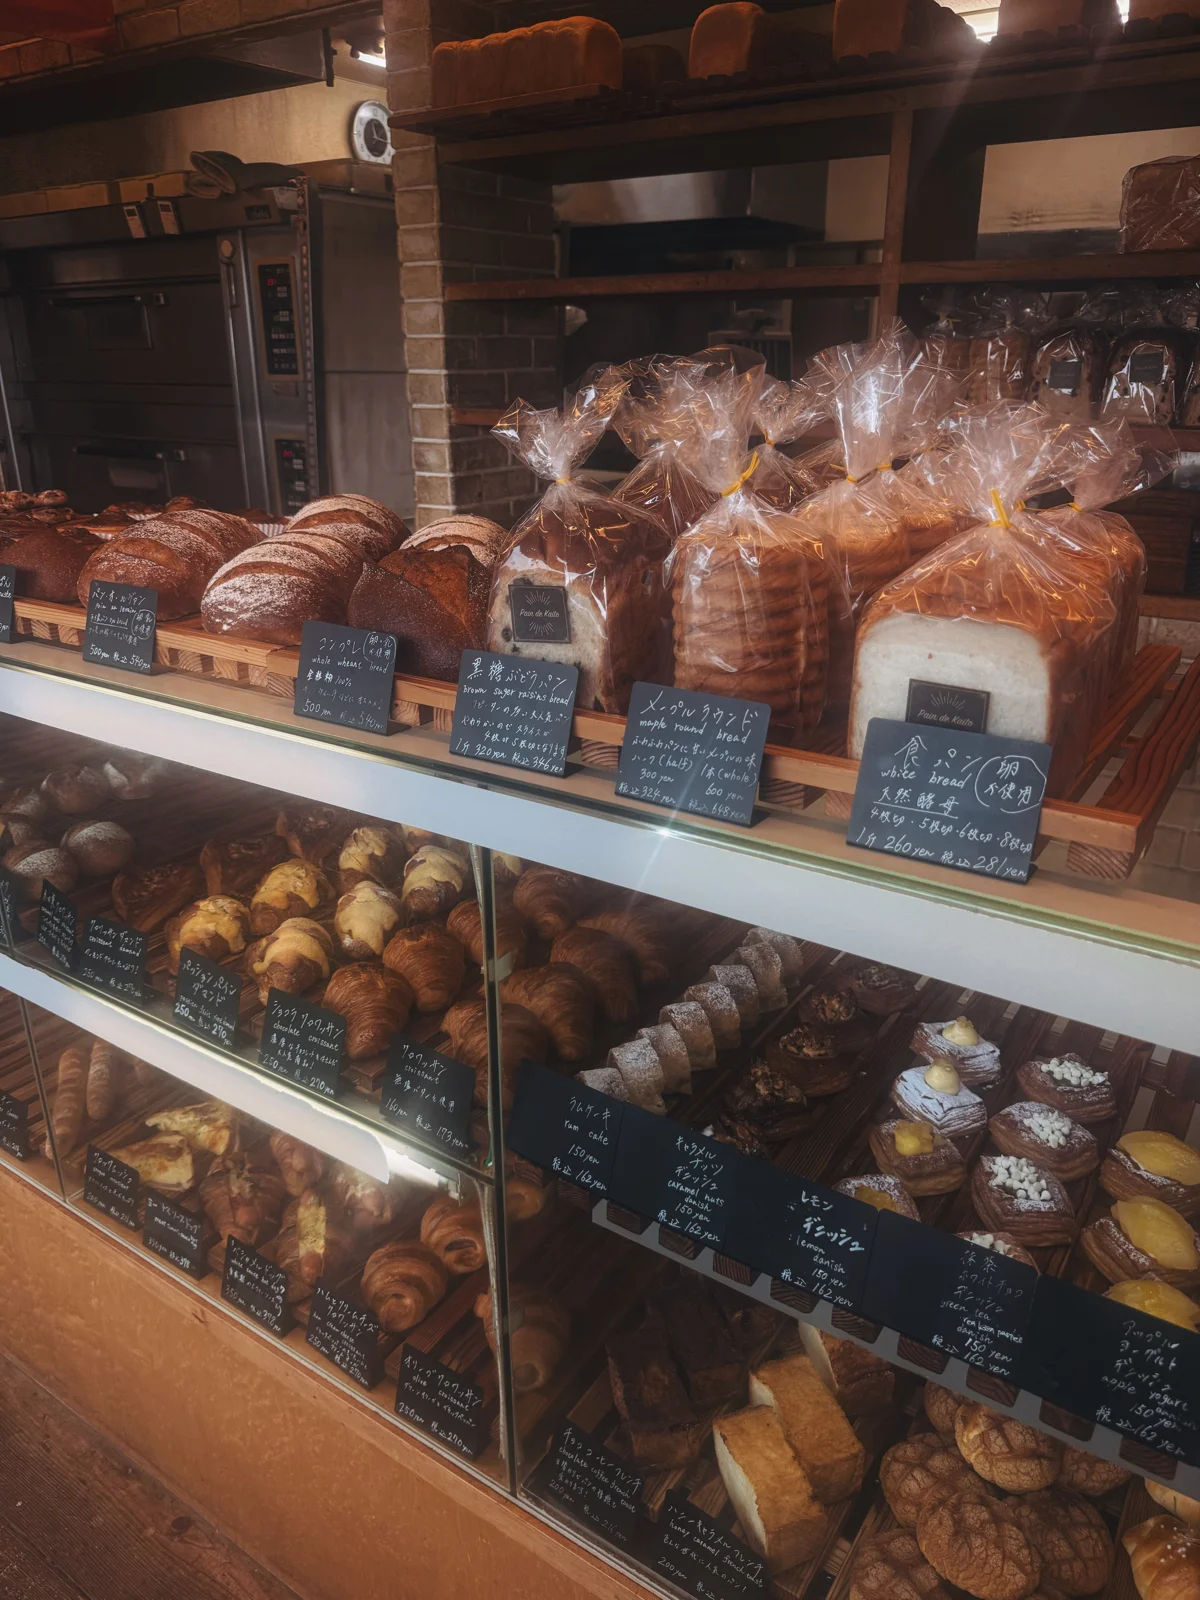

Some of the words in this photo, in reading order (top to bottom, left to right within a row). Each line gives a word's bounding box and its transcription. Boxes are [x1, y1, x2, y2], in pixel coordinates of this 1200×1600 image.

[519, 608, 534, 618] Pain
[535, 609, 543, 618] de
[543, 609, 560, 618] Kaito
[319, 637, 361, 655] コンプレ
[311, 655, 331, 665] whole
[368, 662, 390, 674] bread
[466, 657, 567, 692] 黒糖ぶどうパン
[463, 684, 488, 695] brown
[518, 690, 547, 702] raisins
[549, 690, 574, 707] bread
[639, 717, 668, 732] maple
[673, 722, 708, 735] round
[716, 728, 752, 745] bread
[917, 709, 938, 721] Pain
[938, 713, 950, 722] de
[951, 715, 974, 727] Kaito
[511, 751, 531, 766] 税込
[894, 735, 982, 775] 食パン
[880, 768, 917, 780] white
[928, 771, 973, 789] bread
[996, 759, 1019, 780] 卵
[618, 782, 639, 796] 税込
[687, 798, 709, 813] 税込
[639, 768, 657, 781] 300
[657, 774, 675, 785] yen
[705, 783, 723, 797] 600
[724, 791, 745, 802] yen
[984, 782, 1032, 807] 不使用
[878, 786, 960, 816] 天然酵母
[940, 849, 971, 868] 税込
[273, 1020, 301, 1037] chocolate
[308, 1034, 339, 1052] croissant
[401, 1043, 448, 1076] クロワッサン
[404, 1064, 440, 1085] croissant
[569, 1096, 612, 1131] ラムケーキ
[563, 1118, 580, 1133] rum
[588, 1130, 609, 1146] cake
[674, 1135, 717, 1160] キャラメル
[552, 1155, 572, 1176] 税込
[674, 1165, 719, 1192] デニッシュ
[688, 1157, 724, 1177] ナッツ
[667, 1179, 700, 1198] caramel
[704, 1193, 725, 1208] nuts
[683, 1195, 713, 1213] danish
[801, 1189, 834, 1212] レモン
[657, 1208, 682, 1229] 税込
[796, 1235, 827, 1255] lemon
[802, 1216, 866, 1253] デニッシュ
[812, 1253, 846, 1275] danish
[780, 1268, 808, 1288] 税込
[811, 1282, 833, 1300] 162
[833, 1295, 854, 1308] yen
[811, 1267, 829, 1281] 150
[829, 1277, 848, 1290] yen
[939, 1299, 969, 1314] green
[974, 1308, 992, 1322] tea
[953, 1284, 1004, 1314] デニッシュ
[326, 1304, 364, 1338] クロワッサン
[956, 1323, 994, 1346] danish
[1122, 1319, 1180, 1350] アップル
[931, 1333, 960, 1355] 税込
[963, 1351, 986, 1367] 162
[986, 1362, 1011, 1378] yen
[964, 1337, 987, 1353] 150
[987, 1349, 1013, 1364] yen
[1119, 1339, 1177, 1371] ヨーグルト
[1101, 1375, 1137, 1396] apple
[1113, 1357, 1173, 1393] デニッシュ
[411, 1373, 429, 1388] olive
[437, 1388, 471, 1413] croissant
[1148, 1390, 1190, 1412] yogurt
[1095, 1404, 1136, 1432] 税込
[1133, 1424, 1158, 1442] 162
[1156, 1437, 1187, 1456] yen
[1129, 1402, 1155, 1419] 150
[1153, 1416, 1182, 1433] yen
[558, 1444, 589, 1470] chocolate
[590, 1466, 610, 1485] coffee
[609, 1478, 632, 1500] french
[668, 1518, 691, 1538] honey
[692, 1535, 721, 1557] caramel
[722, 1553, 746, 1575] french
